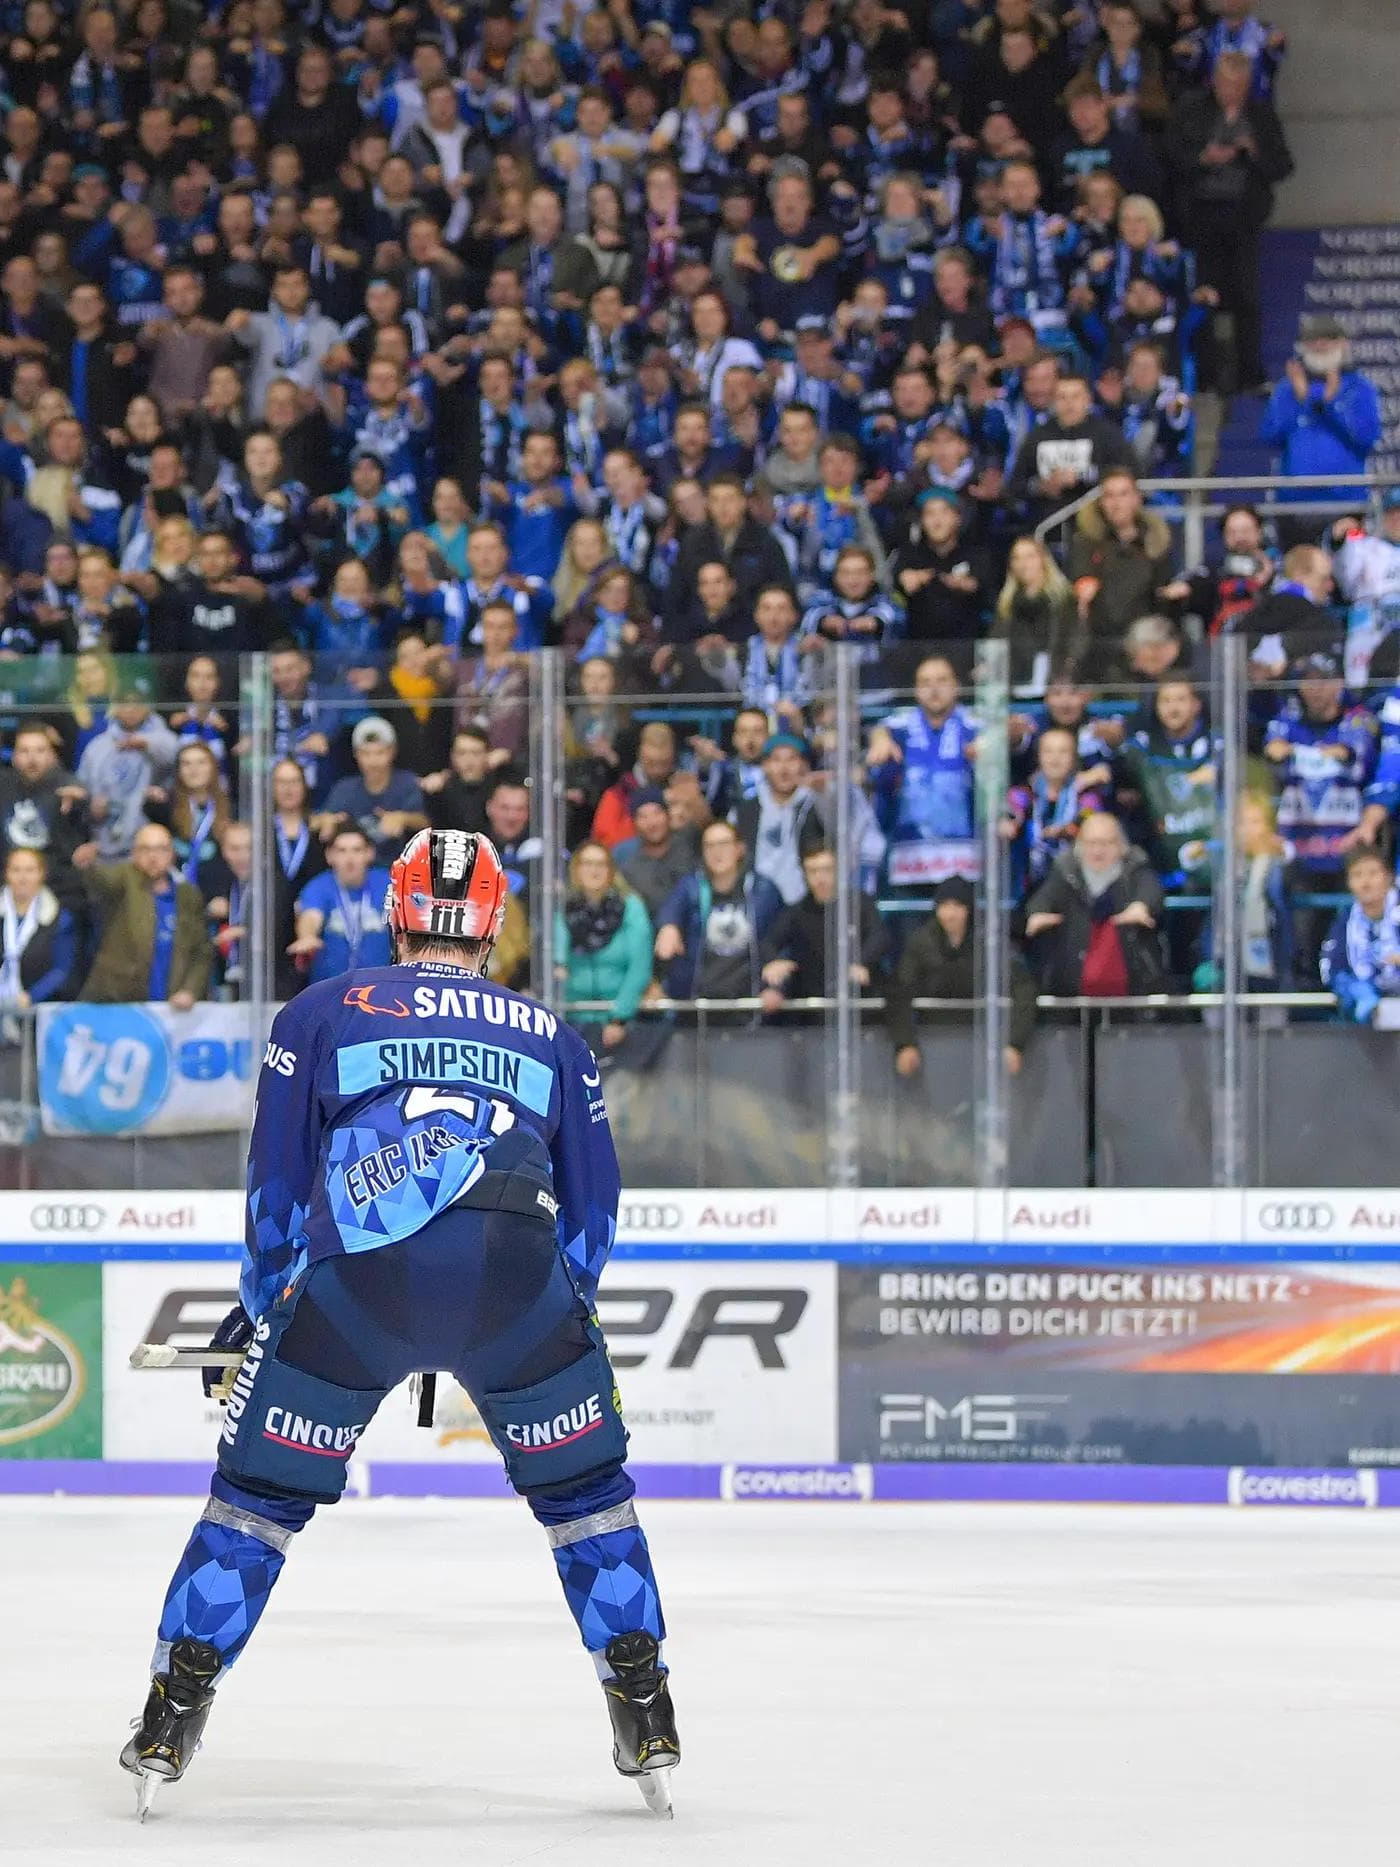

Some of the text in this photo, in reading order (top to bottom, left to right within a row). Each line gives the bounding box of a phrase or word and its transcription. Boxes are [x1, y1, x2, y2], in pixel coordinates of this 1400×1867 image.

[430, 905, 466, 935] fit
[413, 985, 557, 1042] SATURN
[378, 1042, 522, 1094] SIMPSON
[344, 1143, 407, 1209] ERC
[117, 1206, 195, 1229] Audi
[697, 1205, 777, 1227] Audi
[859, 1205, 941, 1227] Audi
[1012, 1205, 1093, 1227] Audi
[878, 1272, 980, 1301] BRING
[984, 1272, 1051, 1301] DEN
[1057, 1273, 1144, 1302] PUCK
[1151, 1274, 1205, 1302] INS
[1211, 1274, 1293, 1302] NETZ
[879, 1306, 1198, 1338] BEWIRB DICH JETZT!
[506, 1393, 603, 1447] CINQUE
[731, 1468, 852, 1496] covestro
[1244, 1472, 1357, 1501] covestro
